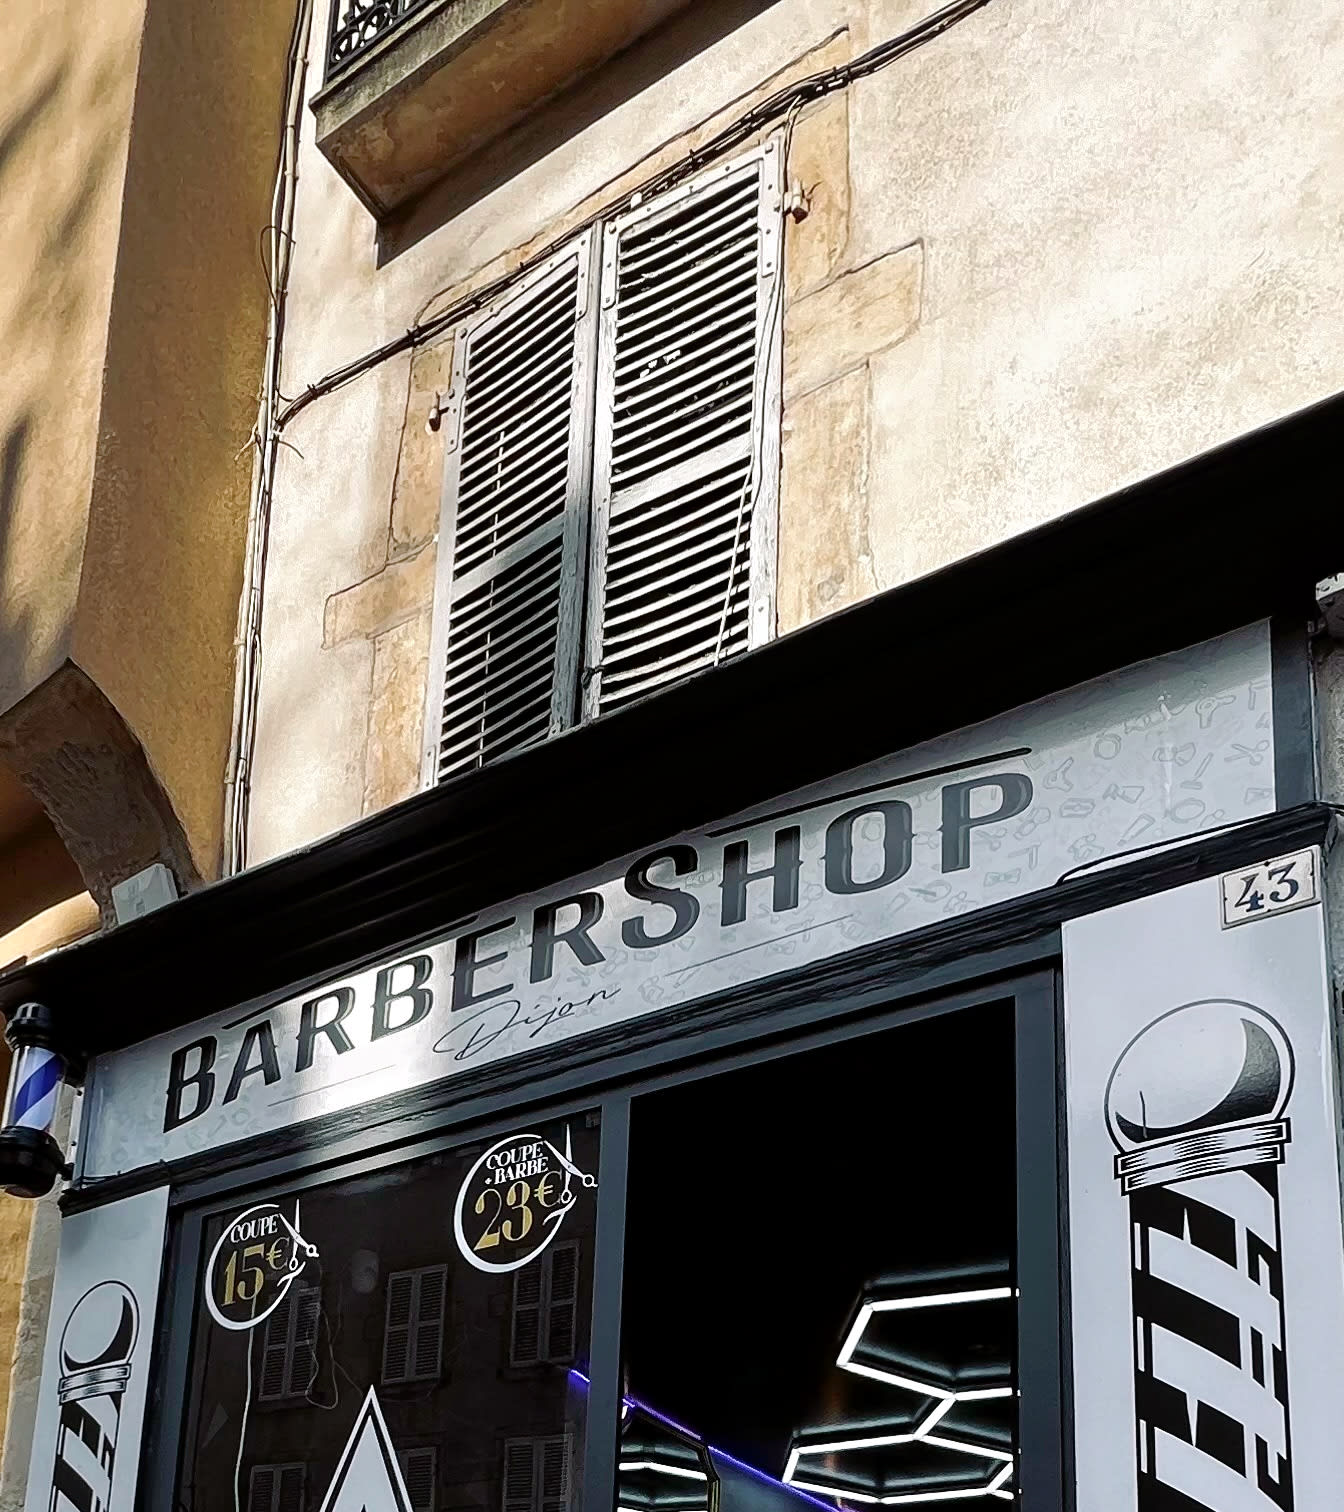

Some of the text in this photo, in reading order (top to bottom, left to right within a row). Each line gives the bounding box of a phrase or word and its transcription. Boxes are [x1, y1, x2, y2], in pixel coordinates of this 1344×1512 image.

[1234, 862, 1299, 913] 43
[162, 772, 1034, 1133] BARBERSHOP
[433, 988, 621, 1060] Dijon
[486, 1141, 544, 1170] COUPE
[230, 1214, 279, 1243] COUPE
[473, 1170, 563, 1252] 23€
[221, 1236, 290, 1307] 15€
